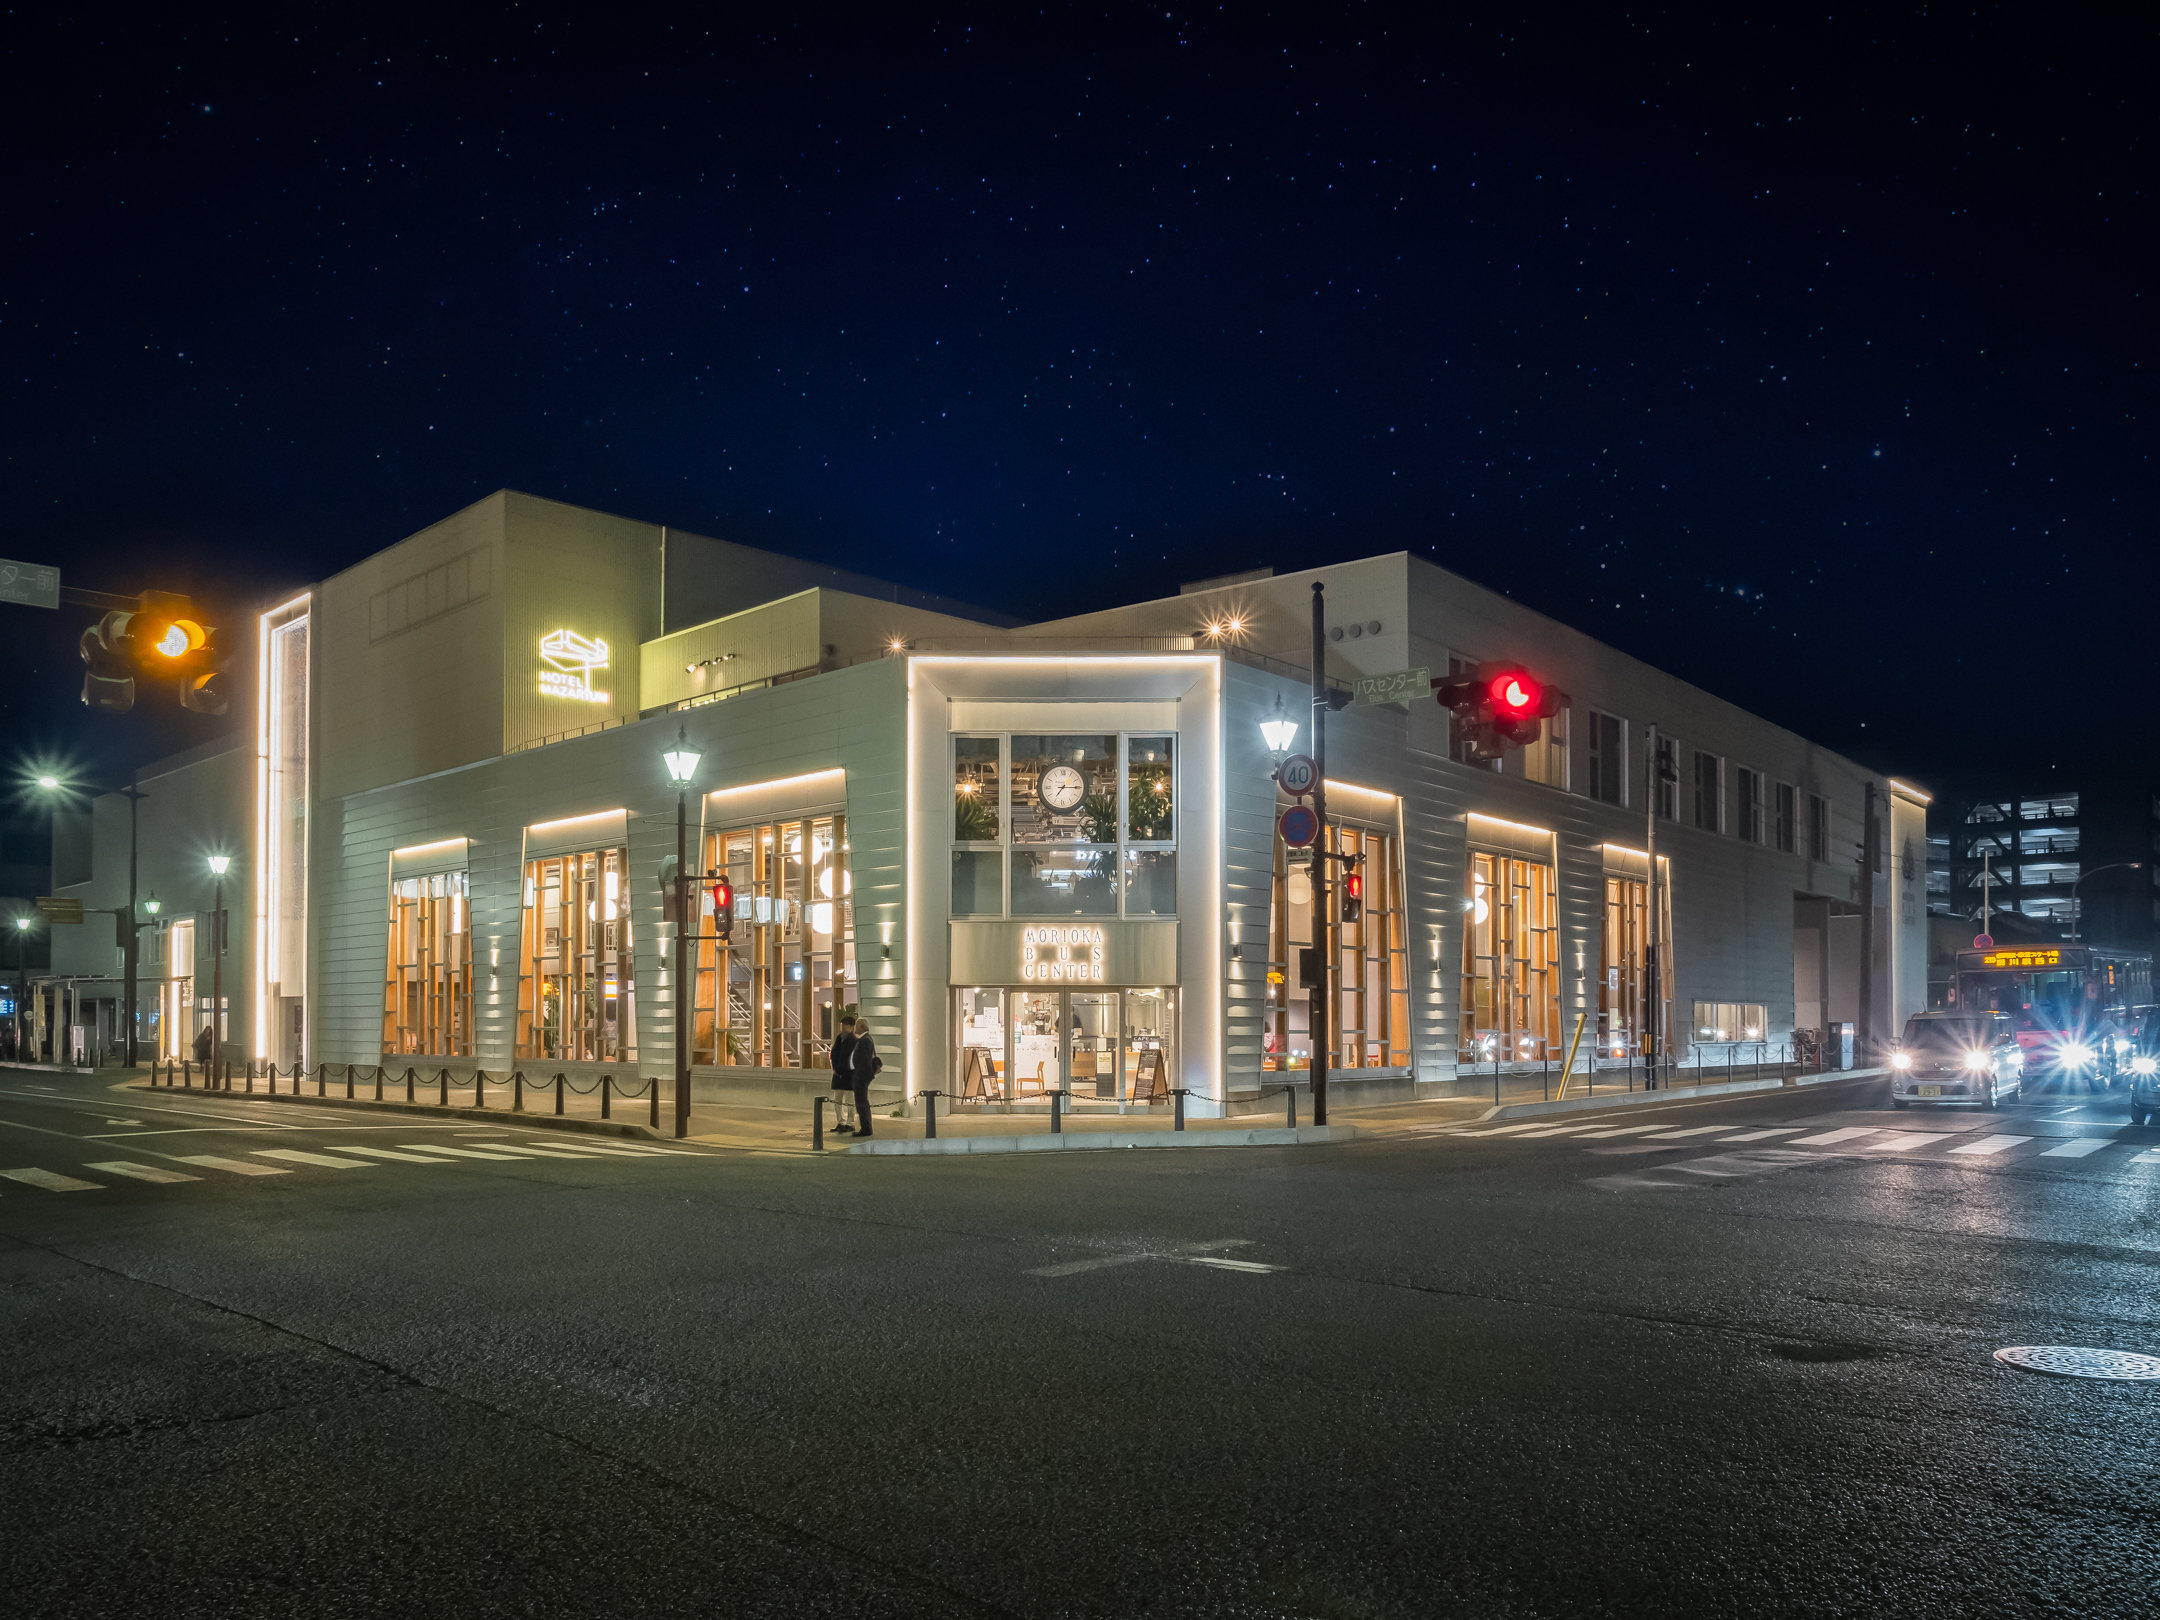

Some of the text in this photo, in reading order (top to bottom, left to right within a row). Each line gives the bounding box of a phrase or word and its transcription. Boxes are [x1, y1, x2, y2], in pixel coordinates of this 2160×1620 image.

[540, 671, 584, 689] HOTEL
[1356, 669, 1428, 696] バスセンター前
[1287, 765, 1309, 785] 40
[1025, 929, 1102, 944] MORIOKA
[1026, 947, 1101, 960] BUS
[1025, 964, 1101, 979] CENTER
